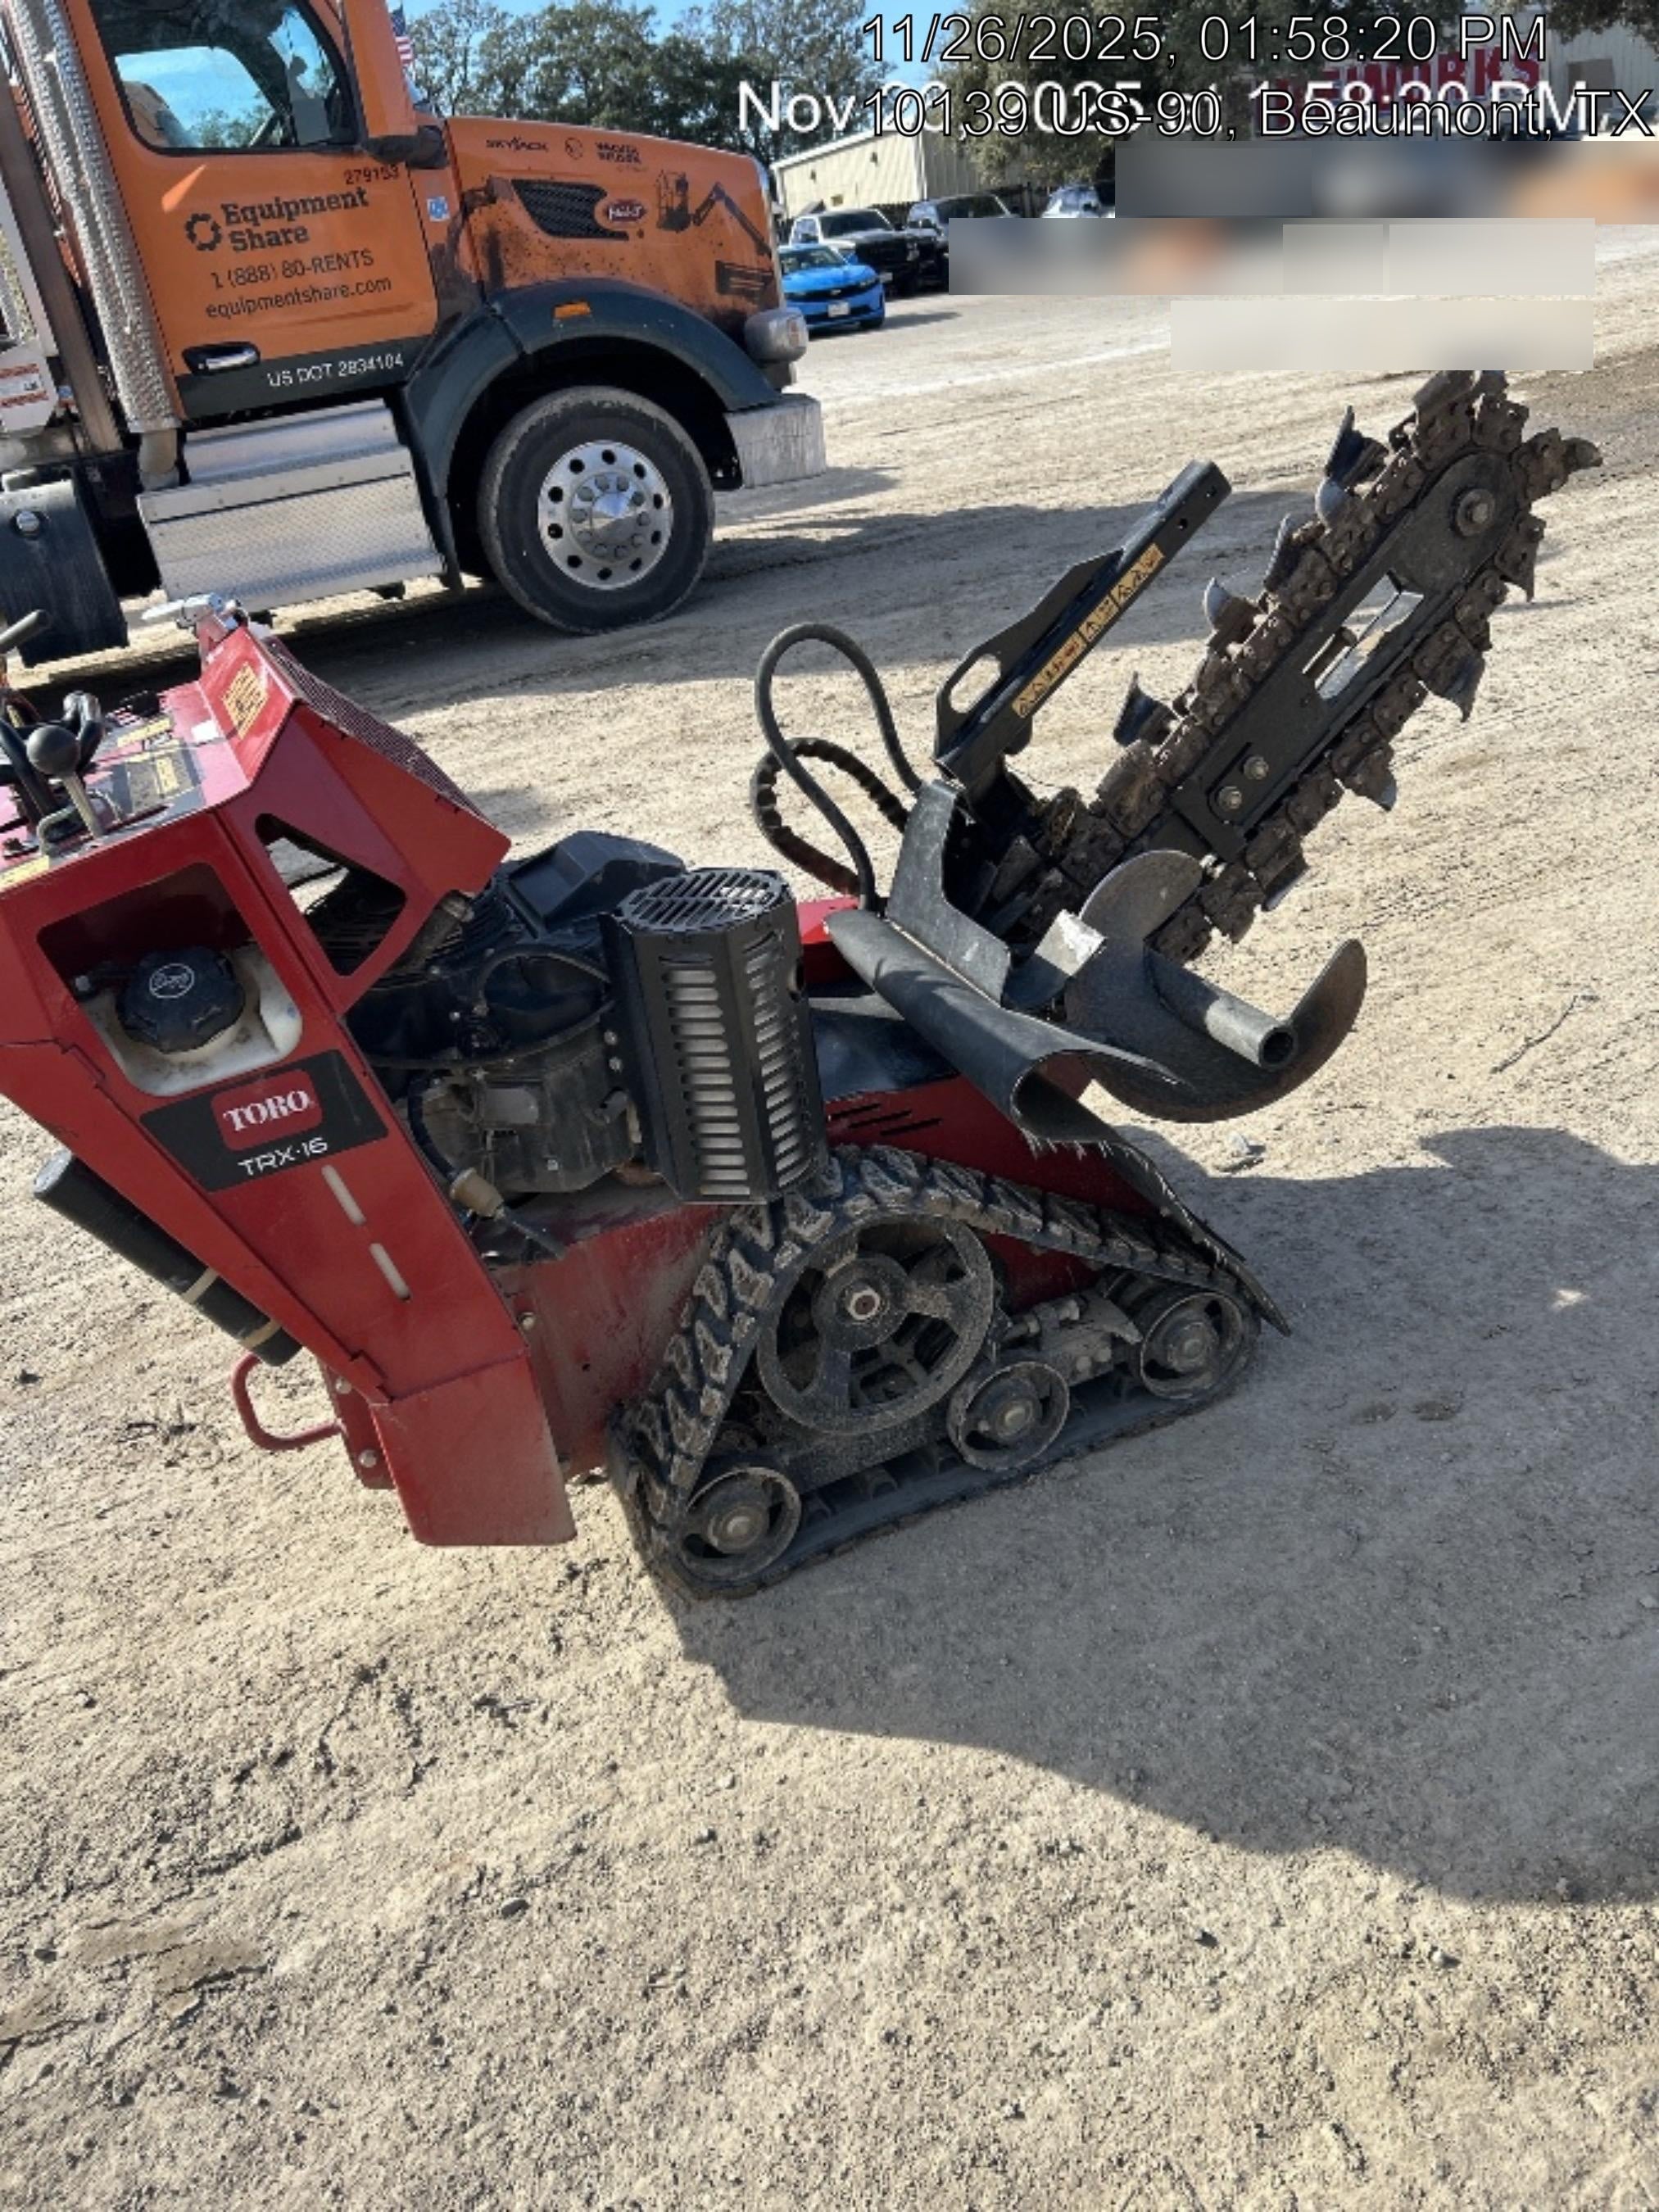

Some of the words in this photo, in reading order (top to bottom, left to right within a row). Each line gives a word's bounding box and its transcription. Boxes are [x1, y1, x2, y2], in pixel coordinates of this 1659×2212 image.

[221, 186, 369, 227] Equipment
[228, 225, 310, 253] Share
[211, 272, 224, 291] 1
[228, 262, 277, 288] (888)
[281, 247, 374, 279] 80-RENTS
[206, 276, 392, 320] equipmentshare.com
[267, 370, 293, 388] US
[297, 363, 333, 384] DOT
[223, 1090, 311, 1132] TORO
